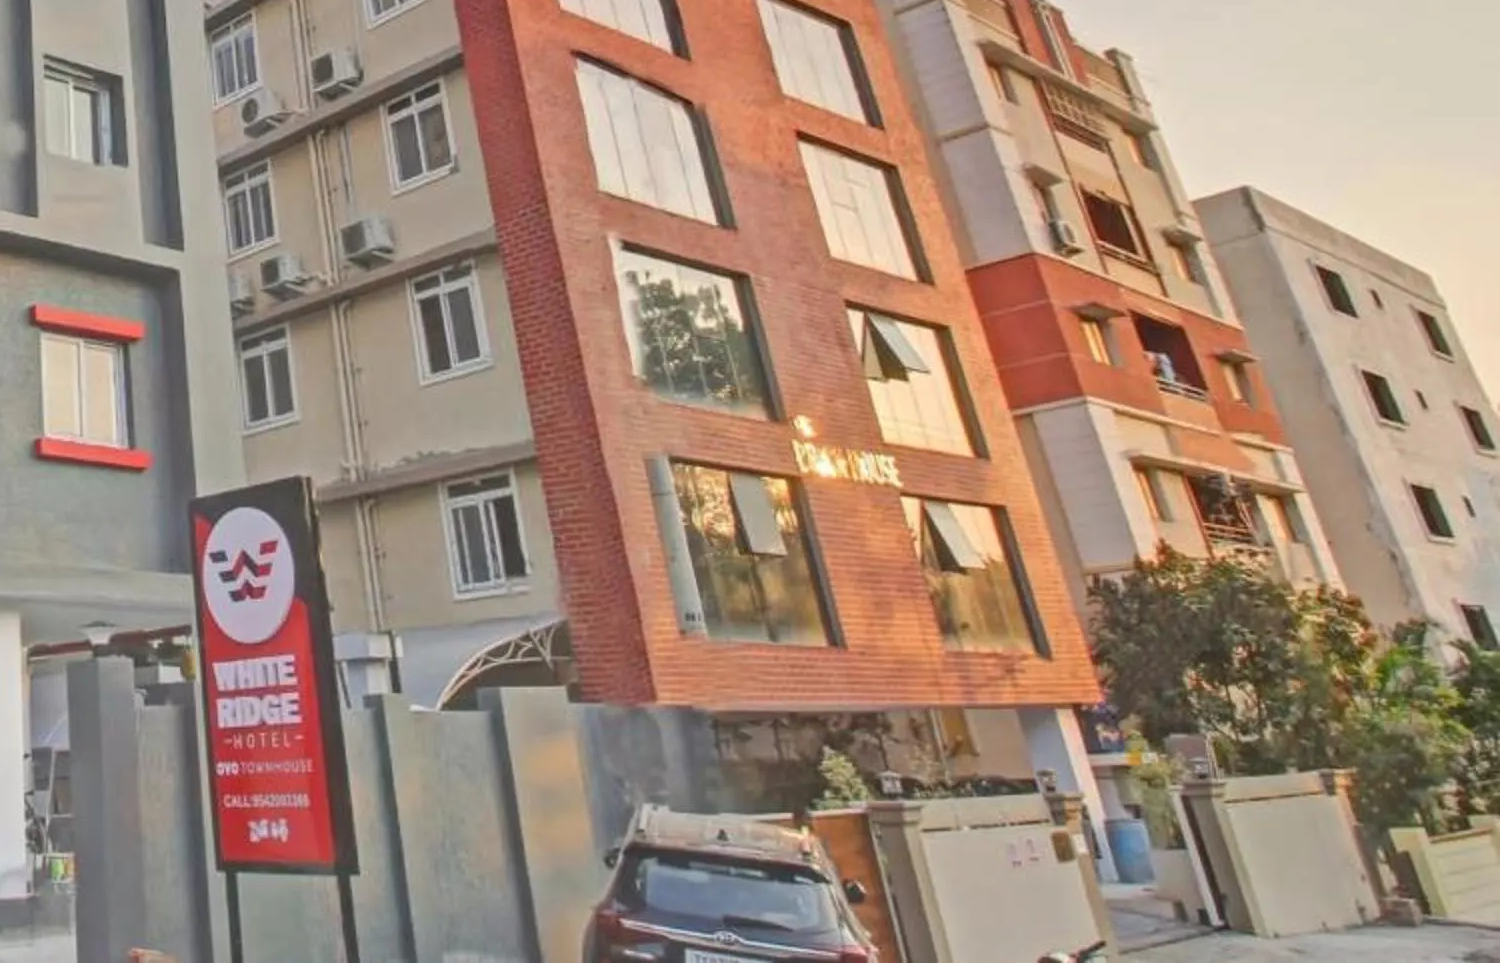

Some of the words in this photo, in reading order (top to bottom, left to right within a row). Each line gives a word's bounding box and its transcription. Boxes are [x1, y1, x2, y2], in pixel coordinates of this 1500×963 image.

[211, 654, 297, 692] WHITE
[215, 692, 303, 729] RIDGE
[240, 757, 316, 775] TOWNHOUSE
